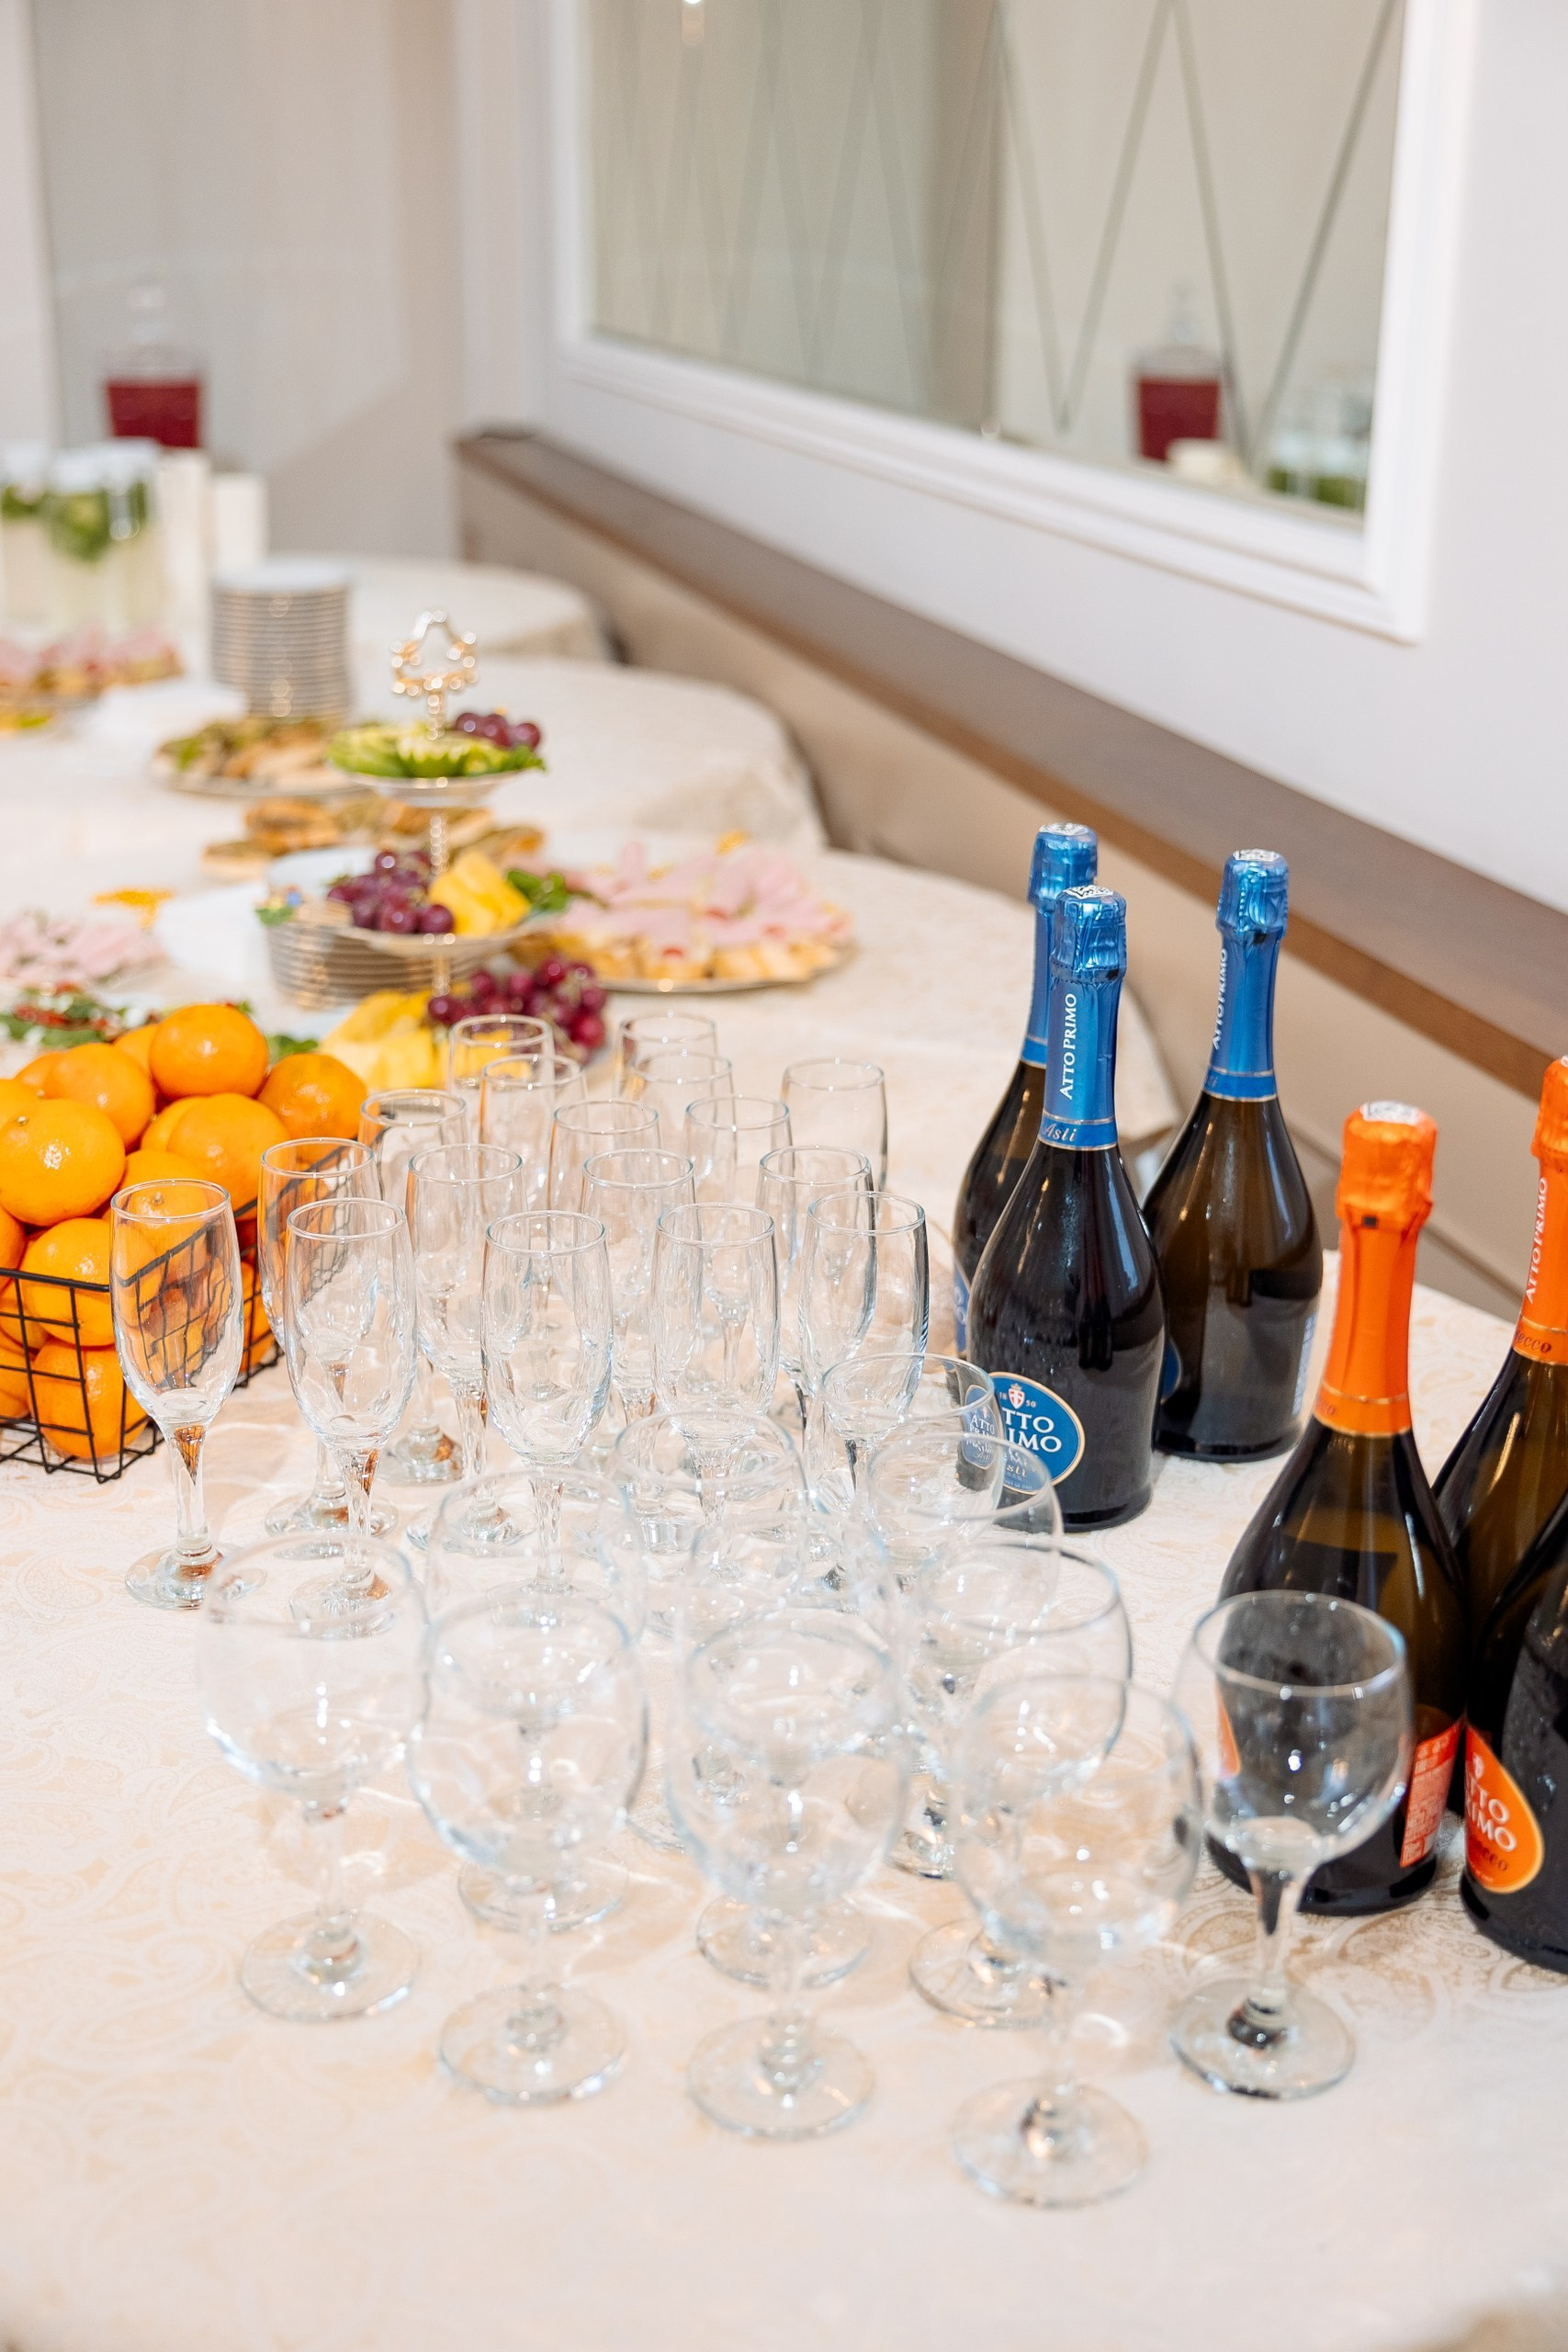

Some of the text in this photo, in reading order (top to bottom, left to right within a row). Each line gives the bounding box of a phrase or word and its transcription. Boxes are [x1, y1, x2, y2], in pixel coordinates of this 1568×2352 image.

[1059, 993, 1077, 1101] ATTO PRIMO
[1042, 1123, 1077, 1143] Asti
[1526, 1177, 1548, 1305] ATTO PRIMO
[1001, 1407, 1055, 1433] TTO
[1008, 1428, 1062, 1453] IMO
[1470, 1772, 1509, 1825] TTO
